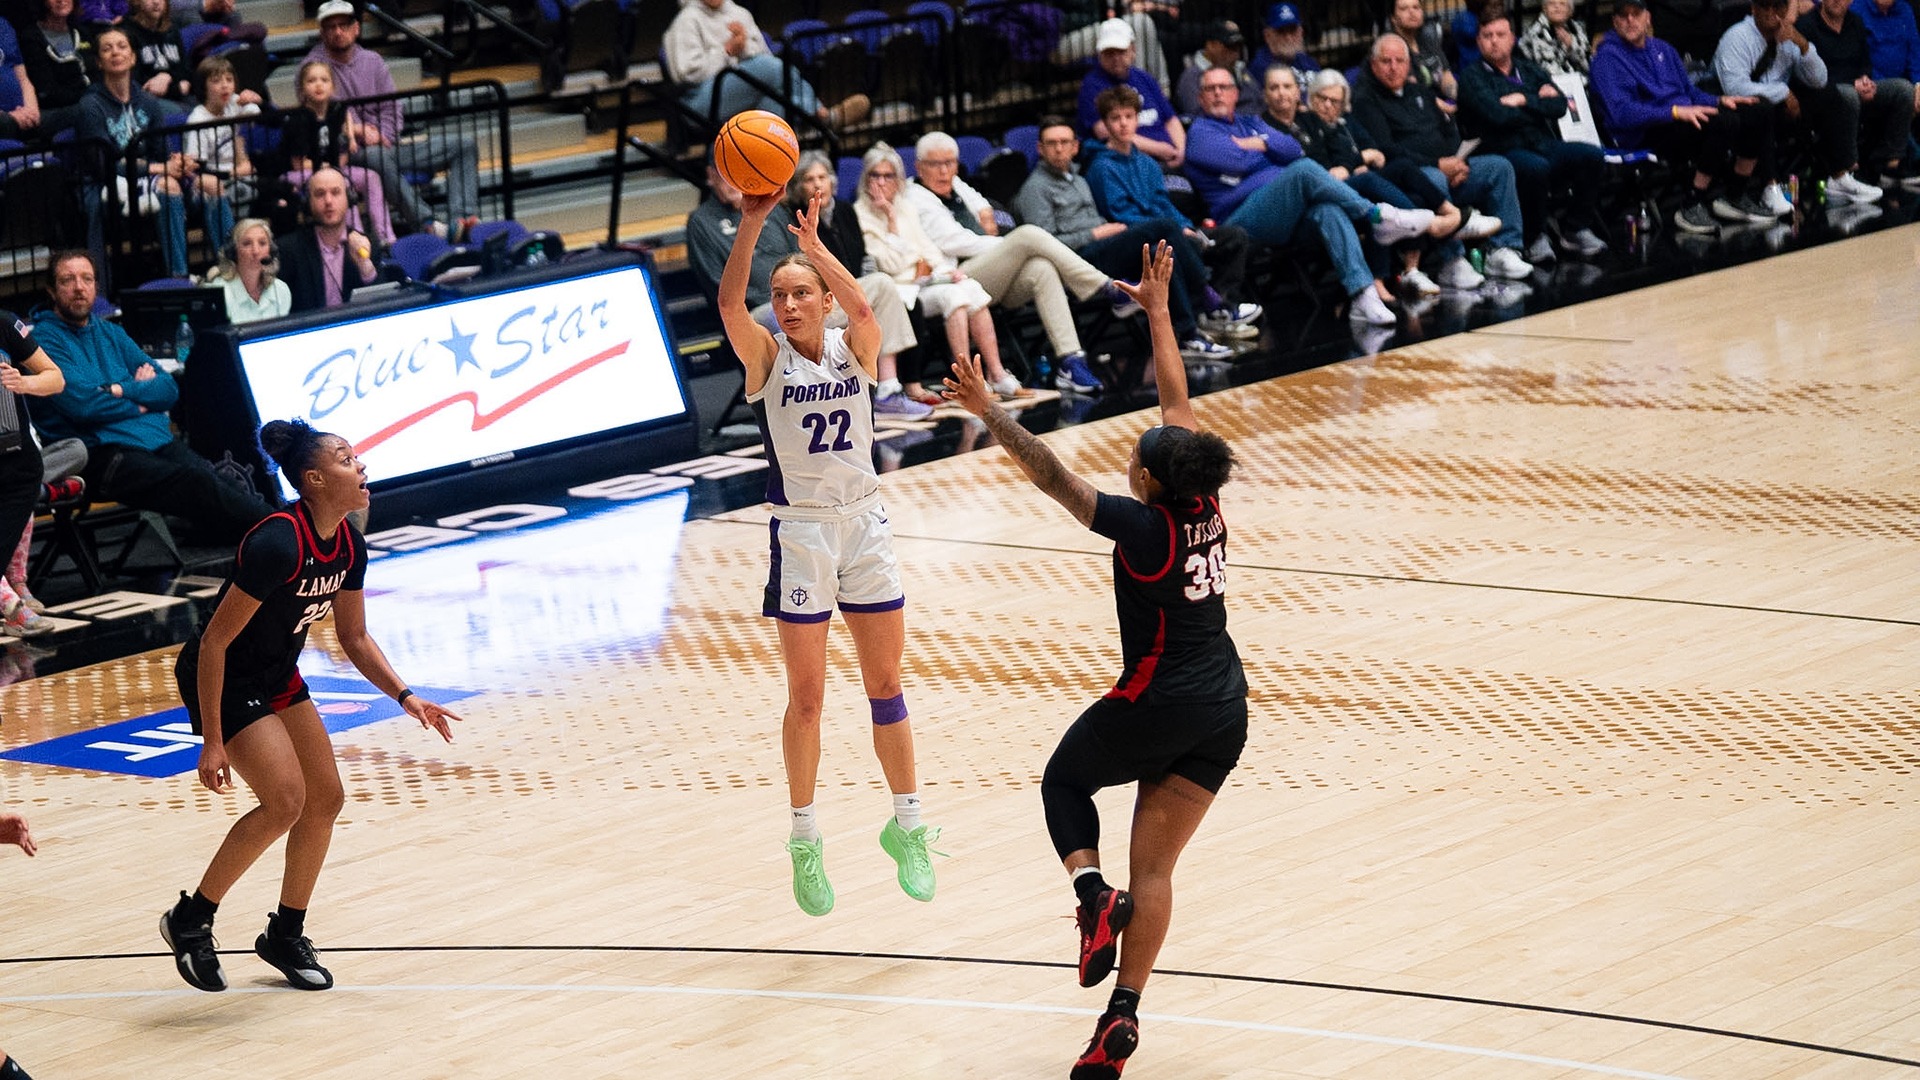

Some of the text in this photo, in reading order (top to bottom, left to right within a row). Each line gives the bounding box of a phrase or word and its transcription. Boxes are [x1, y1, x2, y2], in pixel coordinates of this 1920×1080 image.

[302, 298, 609, 420] Blue Star
[781, 375, 861, 407] PORTLAND
[802, 409, 853, 455] 22
[293, 600, 332, 634] 22
